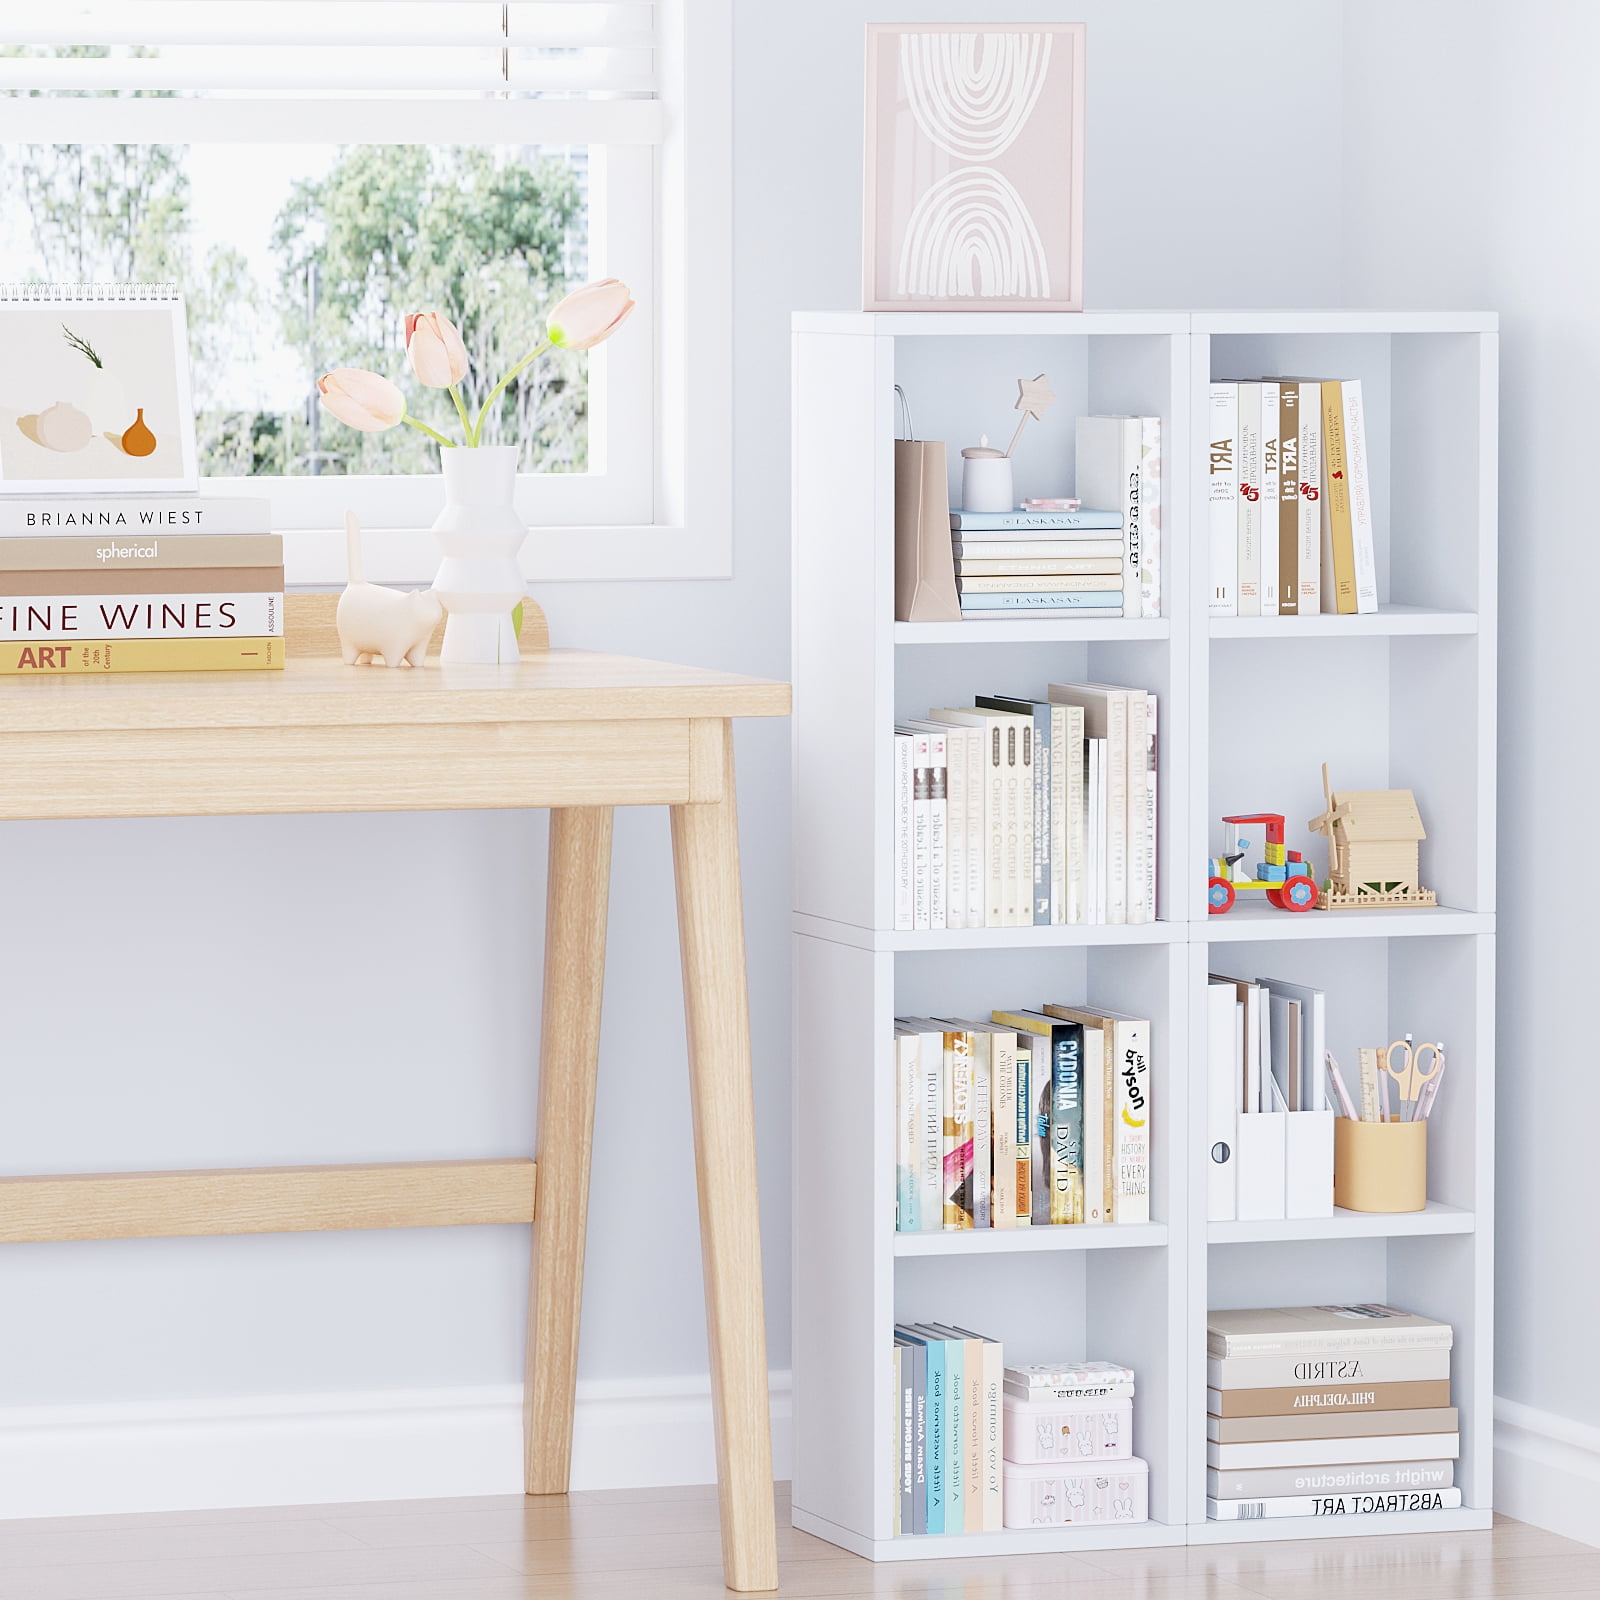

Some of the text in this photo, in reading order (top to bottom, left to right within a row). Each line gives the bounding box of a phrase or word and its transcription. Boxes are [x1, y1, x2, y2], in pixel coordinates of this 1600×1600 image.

[1352, 432, 1364, 484] ГОРМОНАМИ
[26, 511, 204, 526] BRIANNA WIEST
[1016, 517, 1081, 525] LASKASAS
[96, 541, 158, 562] spherical
[1016, 596, 1081, 605] LASKASAS
[0, 602, 237, 632] INE WINES
[17, 646, 72, 669] ART
[82, 646, 90, 658] the
[92, 649, 100, 664] 20th
[104, 644, 112, 670] Century
[1059, 1040, 1078, 1110] CYDONIA
[1136, 1054, 1147, 1074] bill
[953, 1038, 969, 1124] SLOVENKY
[1122, 1049, 1145, 1110] bryson
[977, 1076, 988, 1150] AFTER DAYS
[928, 1072, 938, 1189] ПОНТИЙ ПИЛАТ
[1056, 1126, 1068, 1192] DAVID
[1122, 1143, 1146, 1155] HISTORY
[1122, 1165, 1146, 1180] EVERY
[1122, 1180, 1146, 1196] THING
